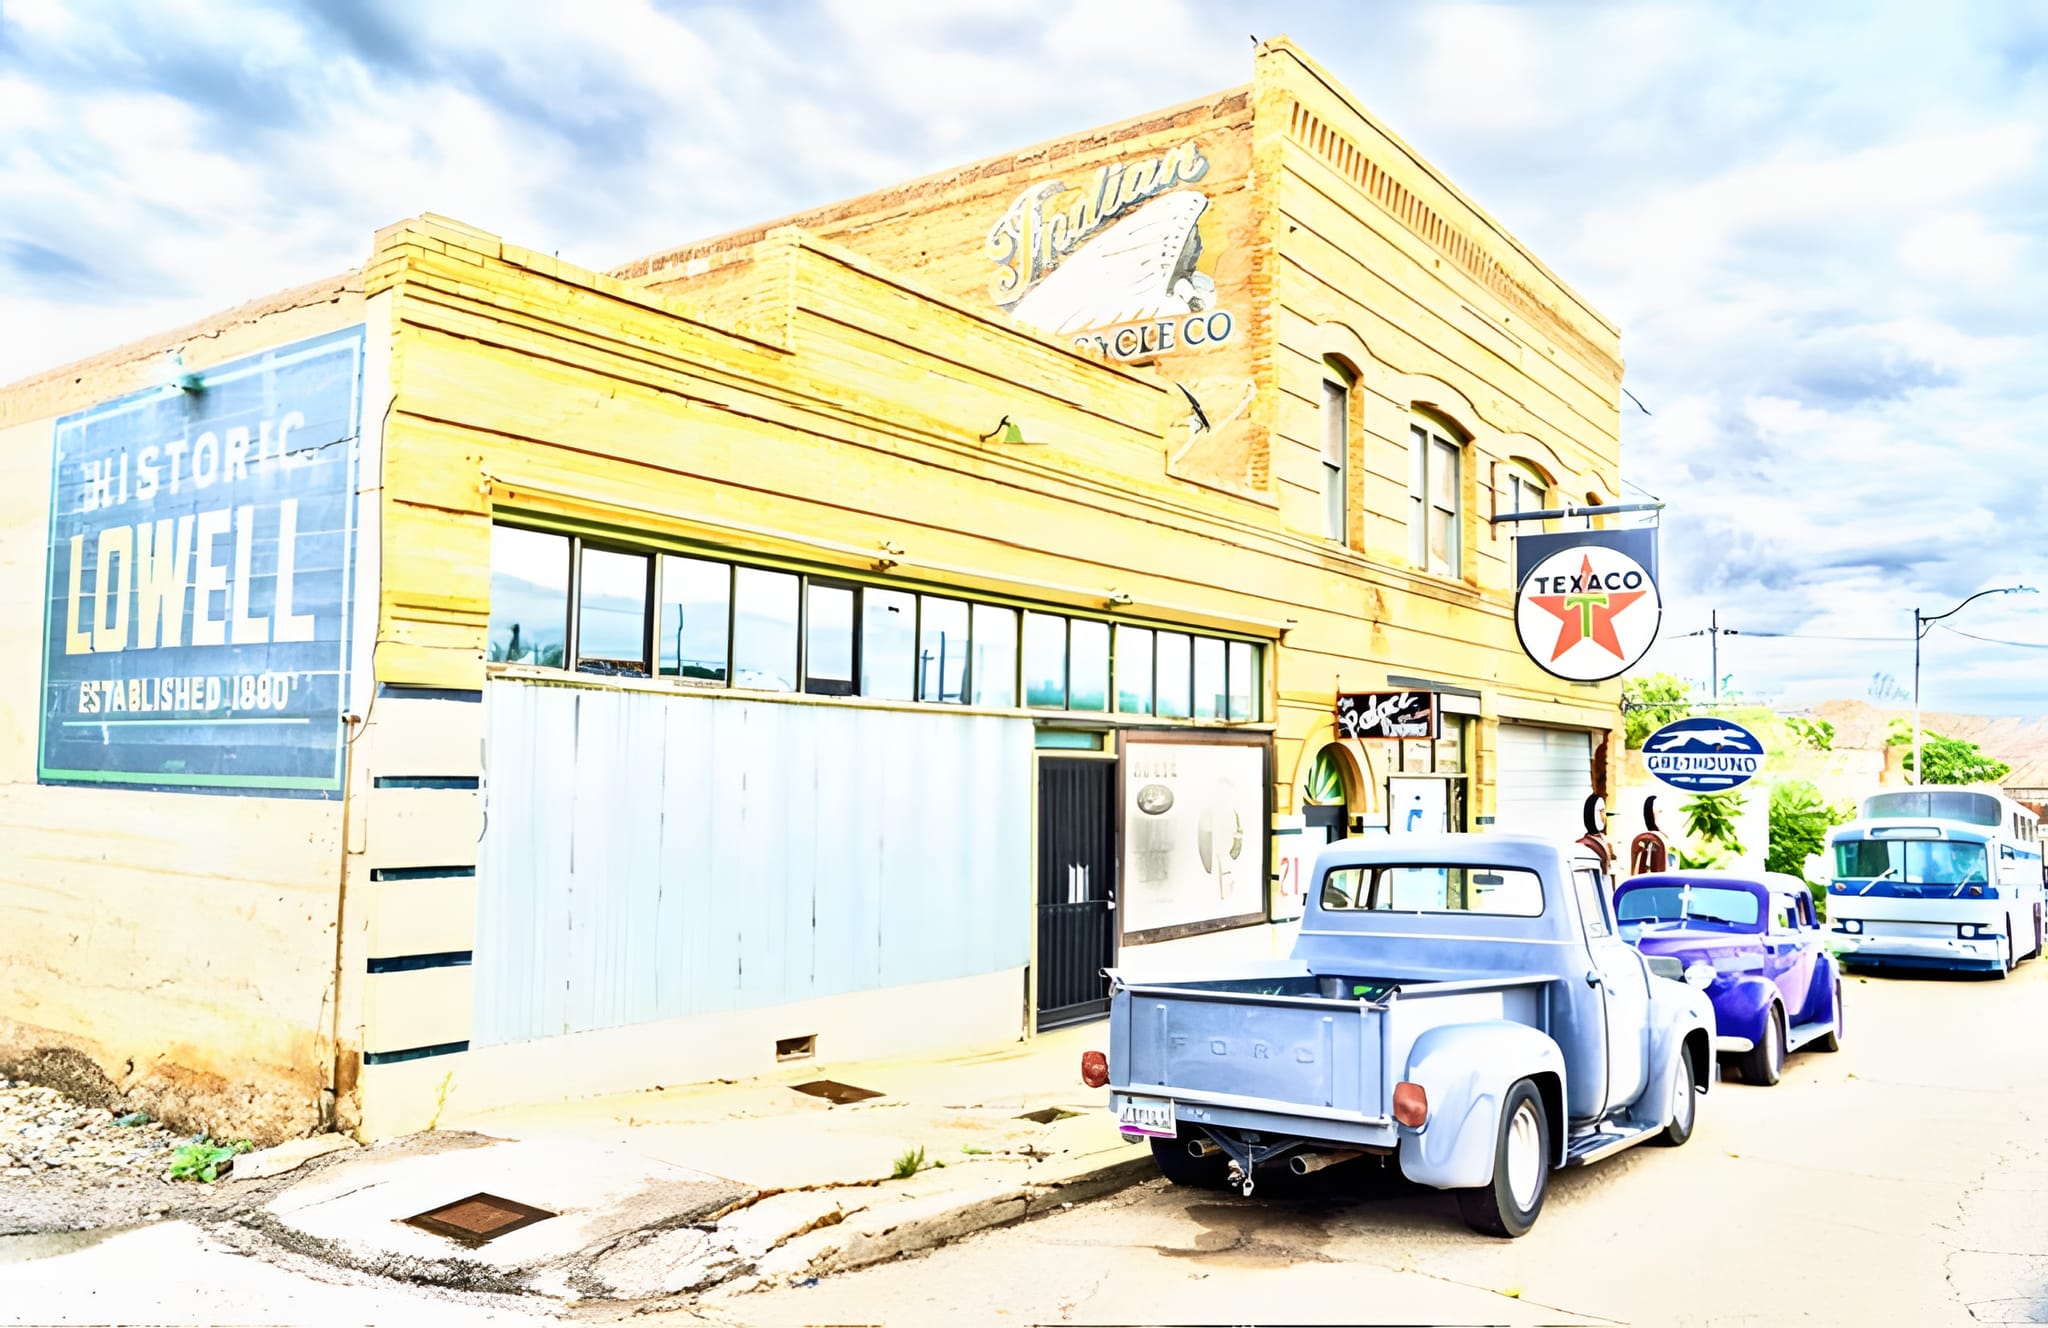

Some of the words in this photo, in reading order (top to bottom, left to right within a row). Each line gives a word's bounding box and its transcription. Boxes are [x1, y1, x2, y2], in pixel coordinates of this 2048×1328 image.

[986, 141, 1210, 311] Indian
[1184, 312, 1232, 345] CO
[84, 410, 307, 511] HISTORIC
[66, 497, 316, 656] LOWELL
[1534, 570, 1643, 595] TEXACO
[79, 678, 222, 713] ESTABLISHED
